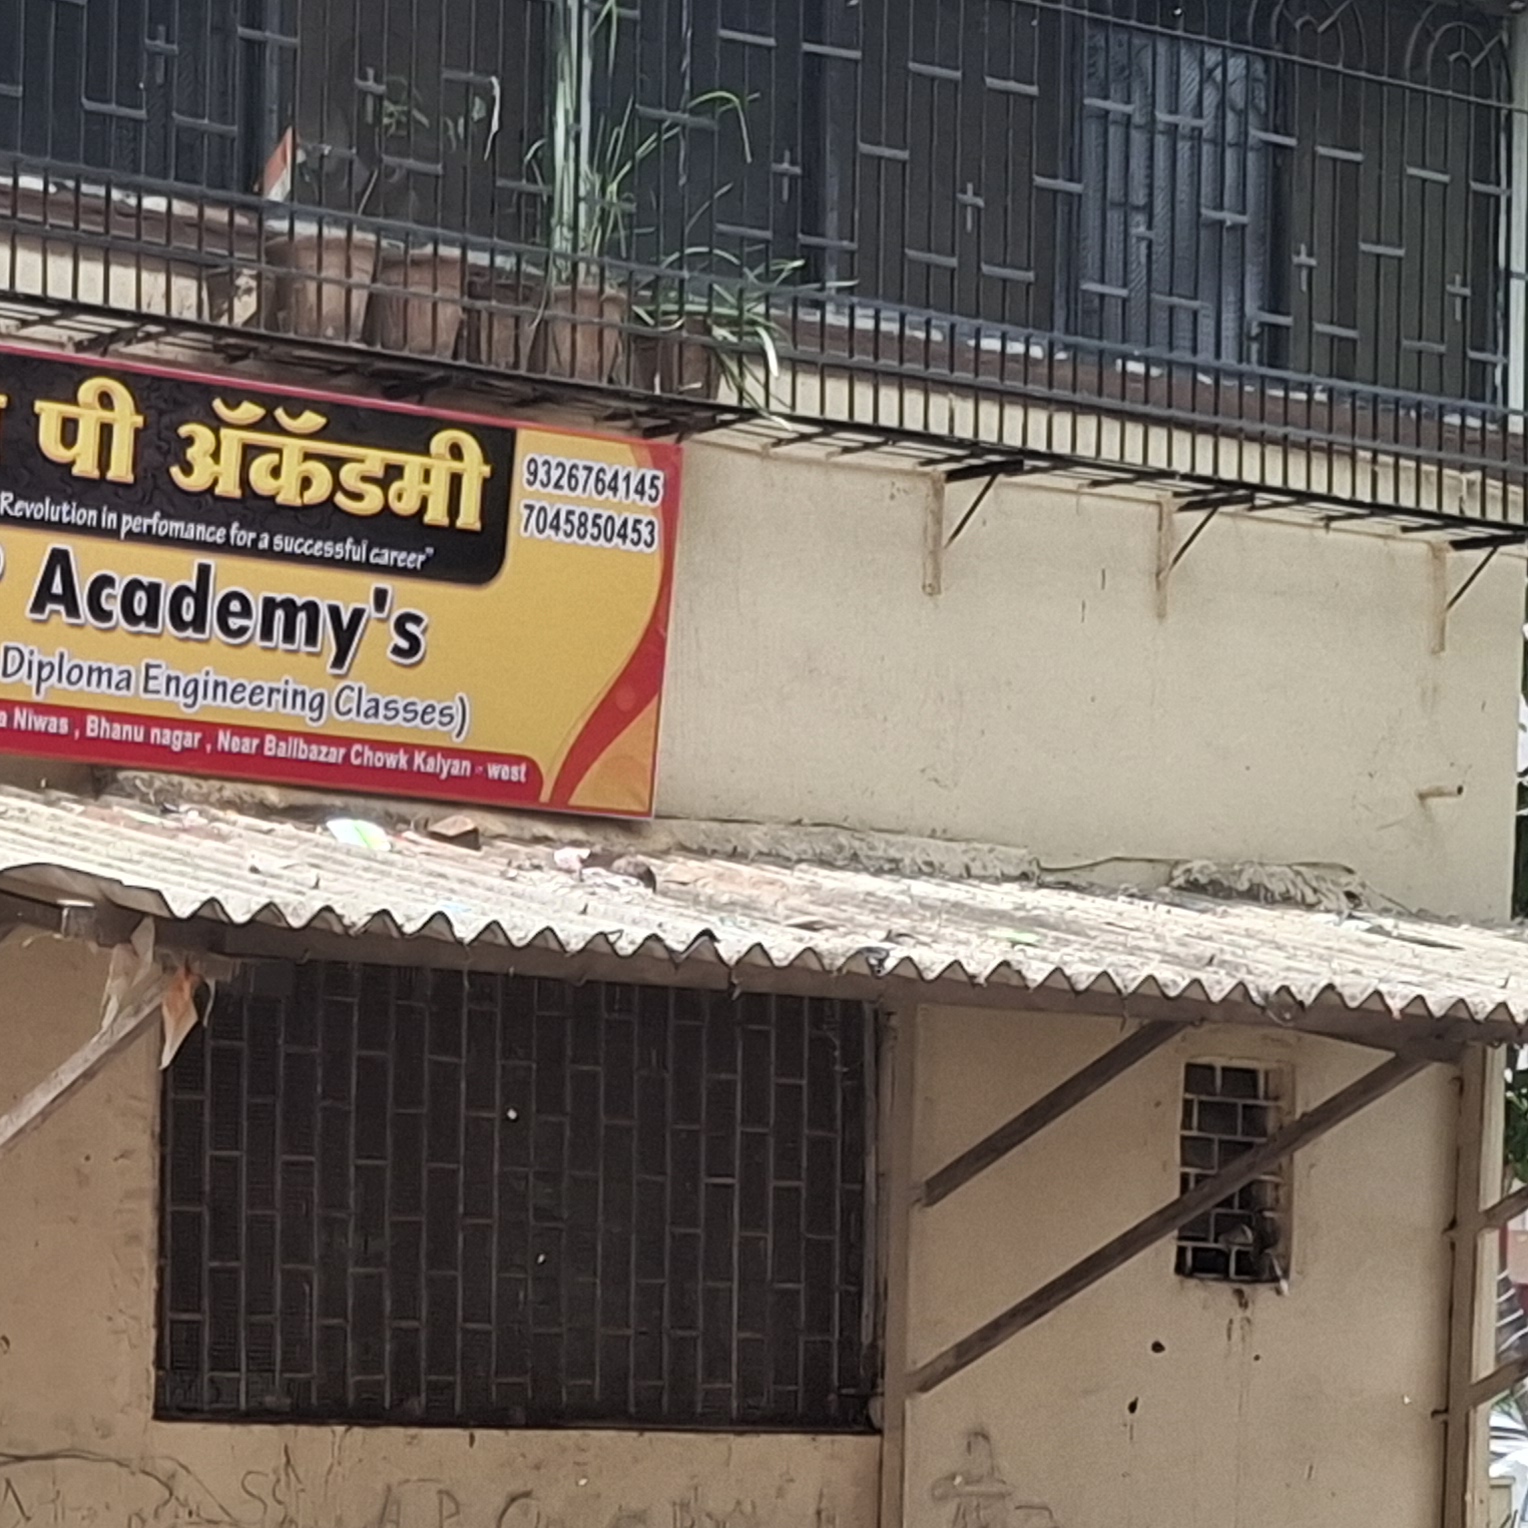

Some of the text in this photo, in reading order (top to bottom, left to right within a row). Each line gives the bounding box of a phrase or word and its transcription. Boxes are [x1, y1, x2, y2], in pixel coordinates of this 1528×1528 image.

[34, 375, 144, 485] पी
[525, 457, 661, 503] 9326764145
[0, 491, 98, 528] Revolution
[101, 505, 118, 530] in
[229, 521, 254, 549] for
[257, 531, 270, 550] a
[272, 534, 368, 564] successful
[523, 503, 656, 548] 7045850453
[0, 645, 132, 697] Diploma
[143, 663, 325, 723] Engineering
[335, 684, 467, 739] Classes)
[13, 706, 69, 735] Niwas
[85, 714, 145, 743] Bhanu
[150, 727, 203, 752] nagar
[217, 728, 259, 754] Near
[350, 743, 408, 771] Chowk
[413, 749, 471, 780] Kalyan
[487, 763, 527, 783] west
